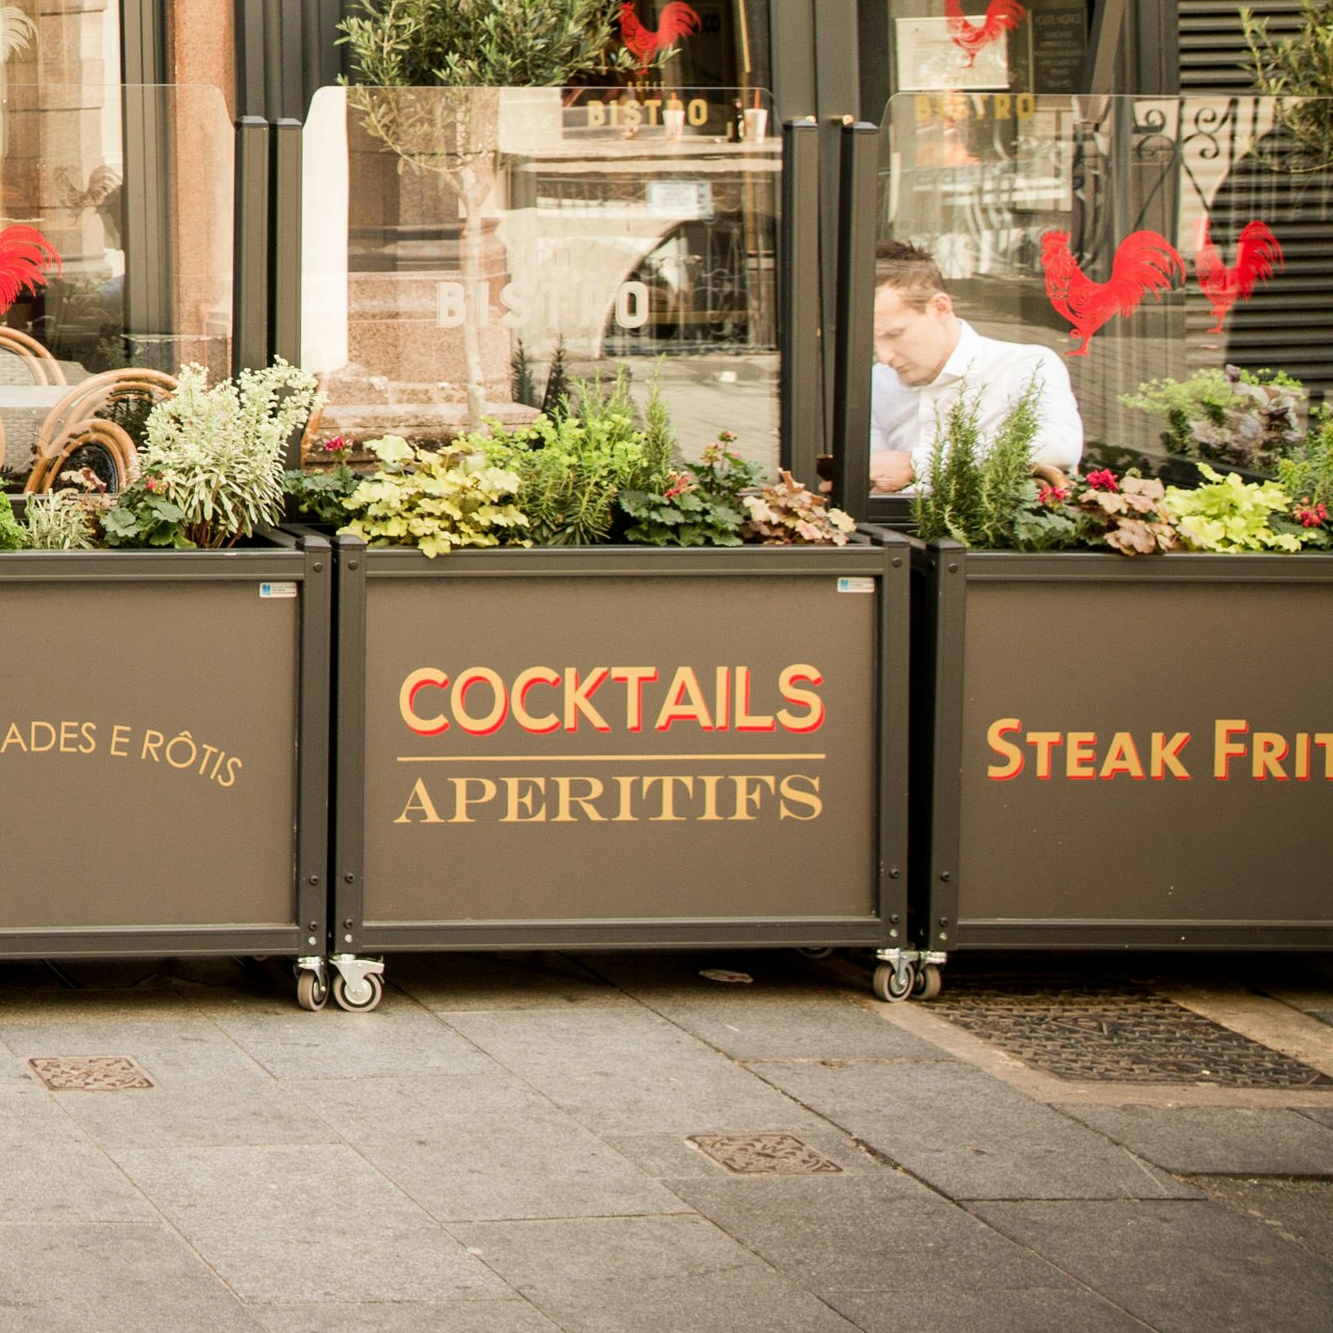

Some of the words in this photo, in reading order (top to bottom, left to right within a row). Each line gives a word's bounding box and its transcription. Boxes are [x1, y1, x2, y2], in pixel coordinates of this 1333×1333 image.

[914, 92, 1036, 121] BTRO
[435, 280, 650, 329] BISTRO
[398, 664, 826, 736] COCKTAILS
[110, 724, 132, 757] E
[140, 730, 243, 788] RÔTIS
[986, 718, 1193, 782] STEAK
[393, 774, 824, 824] APERITIFS
